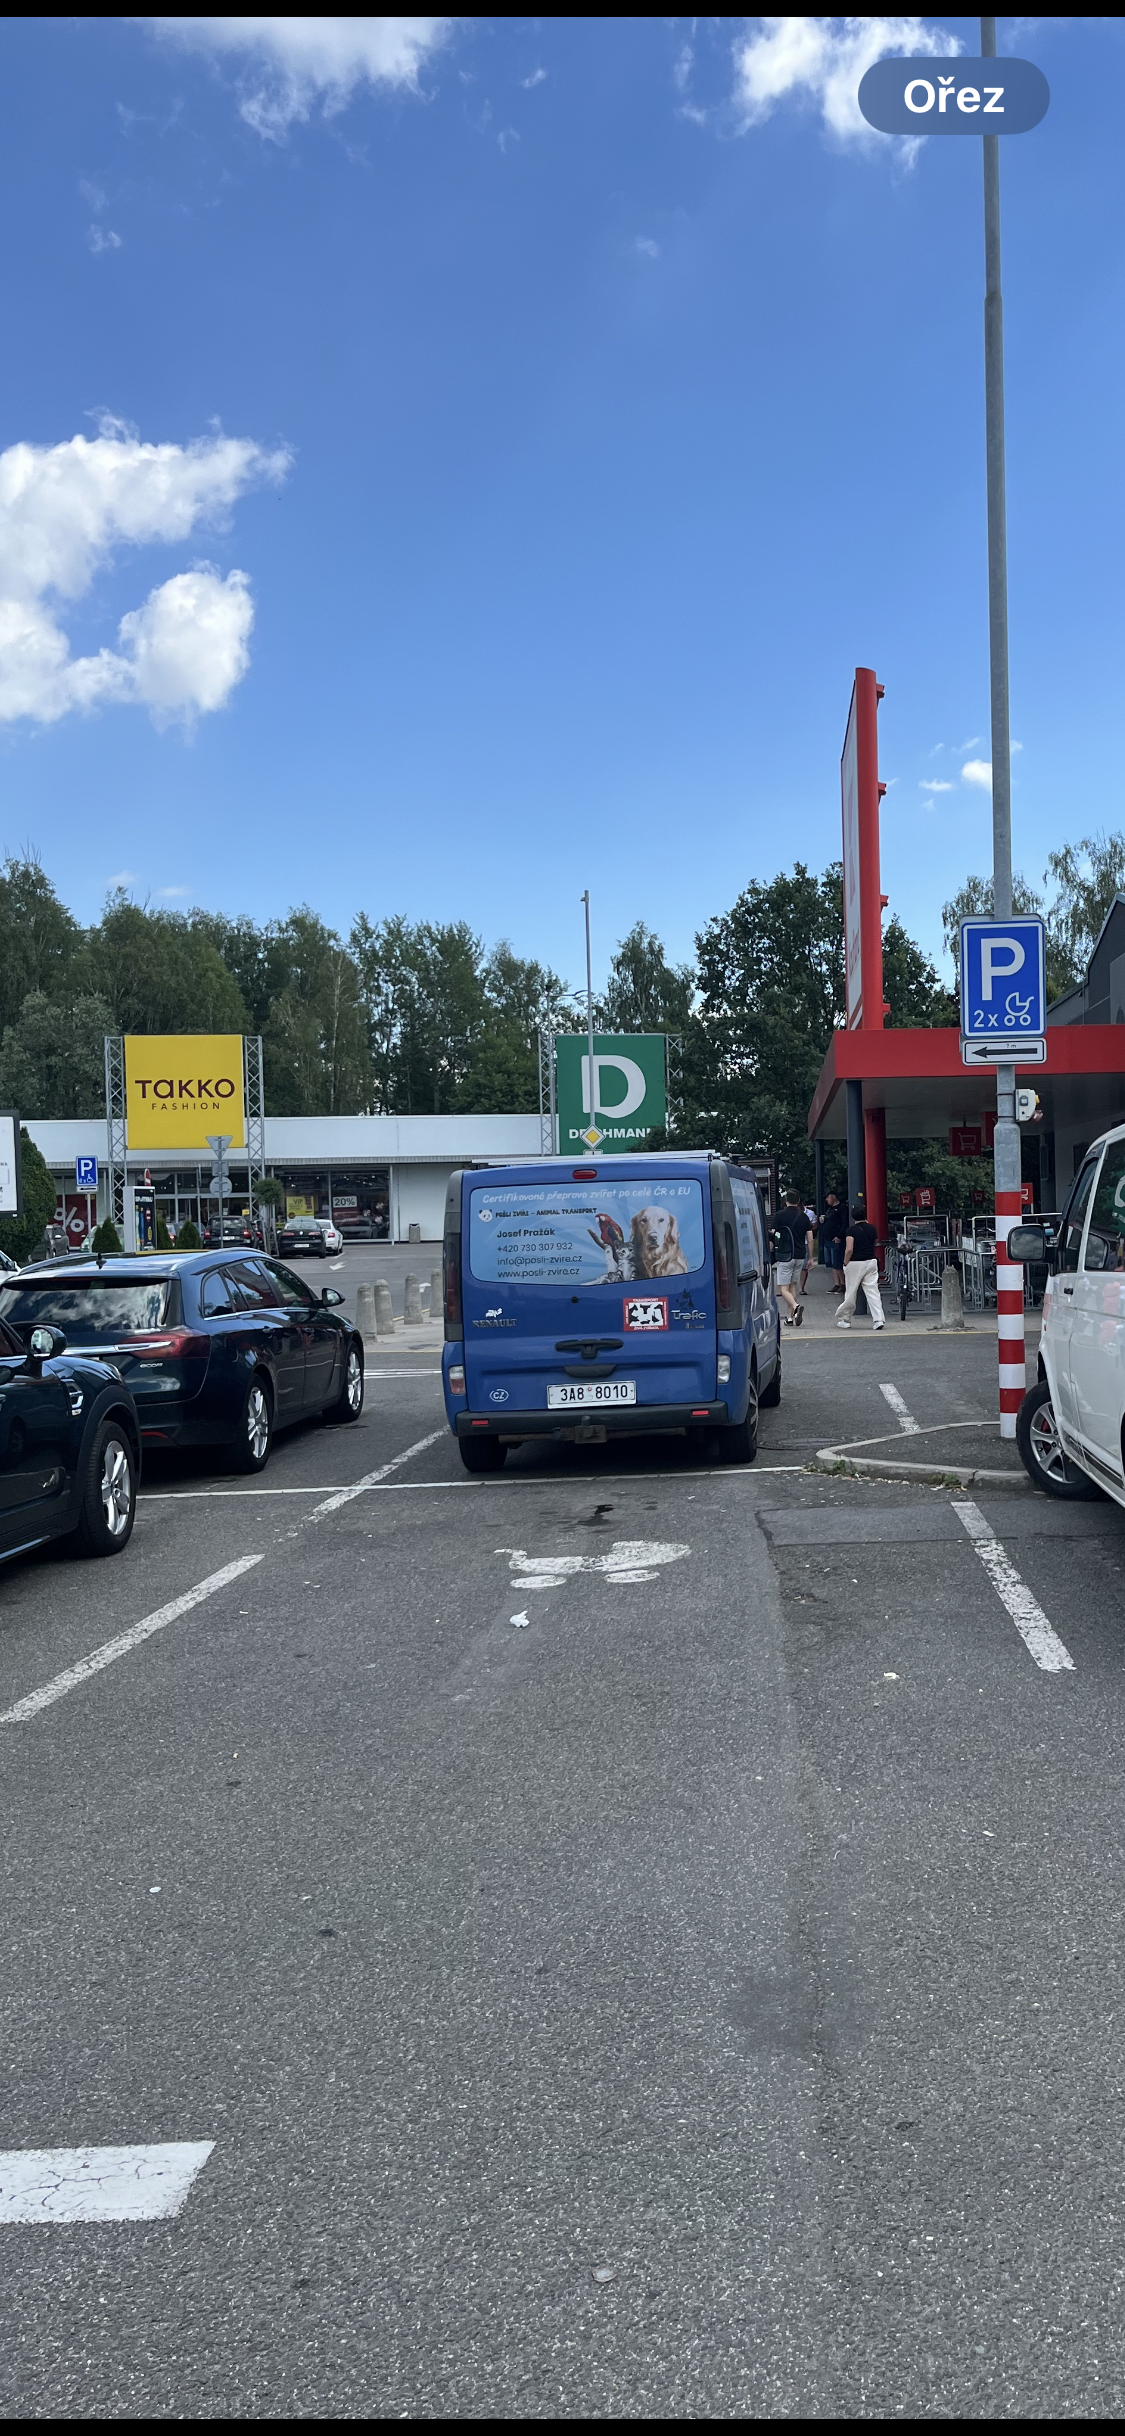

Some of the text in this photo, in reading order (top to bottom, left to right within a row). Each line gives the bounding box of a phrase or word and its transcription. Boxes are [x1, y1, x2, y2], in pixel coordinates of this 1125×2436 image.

[981, 937, 1025, 1001] P
[581, 1055, 647, 1119] D
[151, 1102, 220, 1111] FASHION
[80, 1159, 93, 1177] P
[482, 1191, 545, 1203] Certifikovaná
[547, 1190, 588, 1201] přeprava
[589, 1188, 617, 1199] zvířat
[618, 1190, 630, 1199] po
[632, 1186, 652, 1197] celé
[653, 1186, 668, 1196] ČR
[677, 1186, 691, 1196] EU
[334, 1197, 356, 1206] 20%
[561, 1207, 598, 1215] TRANSPORT
[496, 1227, 556, 1238] Josef Pražák
[497, 1242, 573, 1253] +420 730 307 932
[497, 1254, 583, 1267] info@posli-zvire.cz
[497, 1267, 580, 1279] www.posli-zvire.cz
[671, 1309, 707, 1321] Trafic
[471, 1318, 517, 1328] RENAULT
[493, 1391, 506, 1400] CZ
[560, 1384, 628, 1401] 3A8 8010
